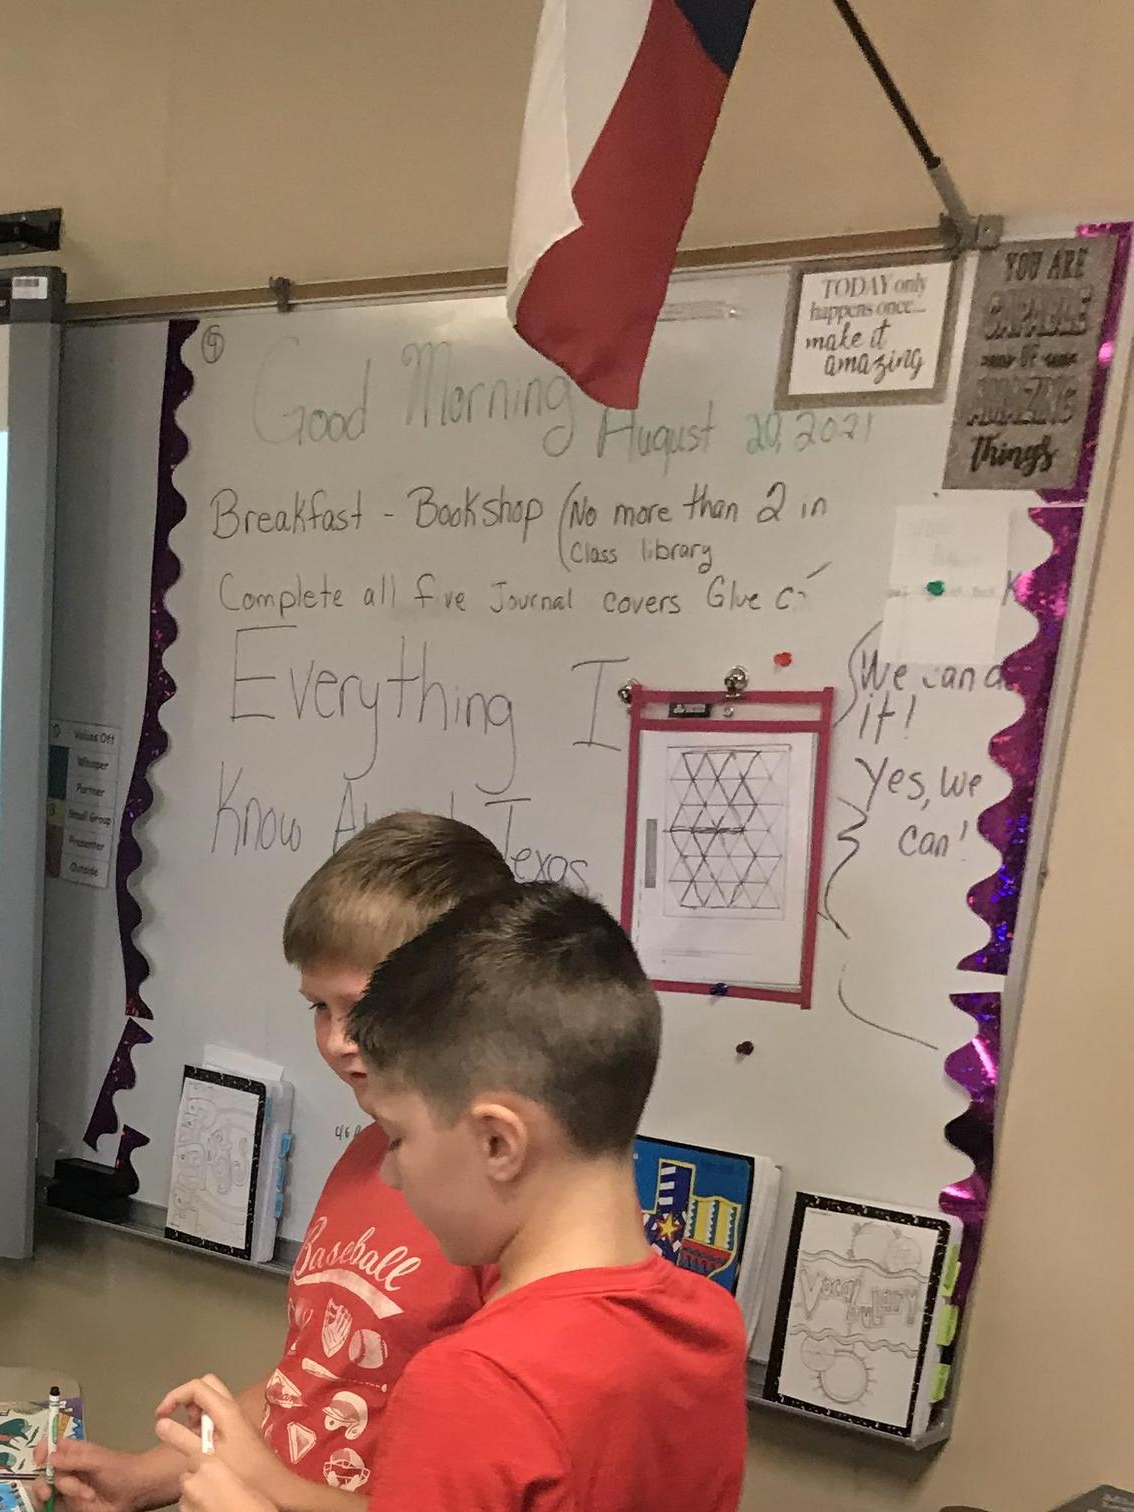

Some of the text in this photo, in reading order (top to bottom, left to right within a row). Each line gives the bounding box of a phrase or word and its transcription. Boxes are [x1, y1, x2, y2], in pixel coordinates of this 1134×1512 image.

[823, 272, 927, 299] TODAY only
[1005, 248, 1087, 281] YOU ARE
[805, 319, 892, 351] make it
[809, 301, 873, 326] happens
[824, 346, 924, 384] amazing
[253, 336, 573, 457] Good Morning
[597, 400, 714, 475] August
[210, 487, 365, 541] Breakfast
[407, 484, 545, 543] Bookshop
[613, 503, 673, 530] more
[683, 484, 739, 523] than
[756, 481, 788, 524] 2
[801, 492, 828, 518] in
[640, 538, 713, 574] library
[219, 571, 344, 618] Complete
[363, 573, 397, 604] all
[490, 580, 573, 614] Journal
[603, 585, 683, 616] covers
[706, 576, 762, 612] Glue
[230, 624, 630, 796] Everything I
[211, 760, 302, 857] Know
[854, 755, 931, 814] Yes,
[294, 1215, 421, 1294] Baseball
